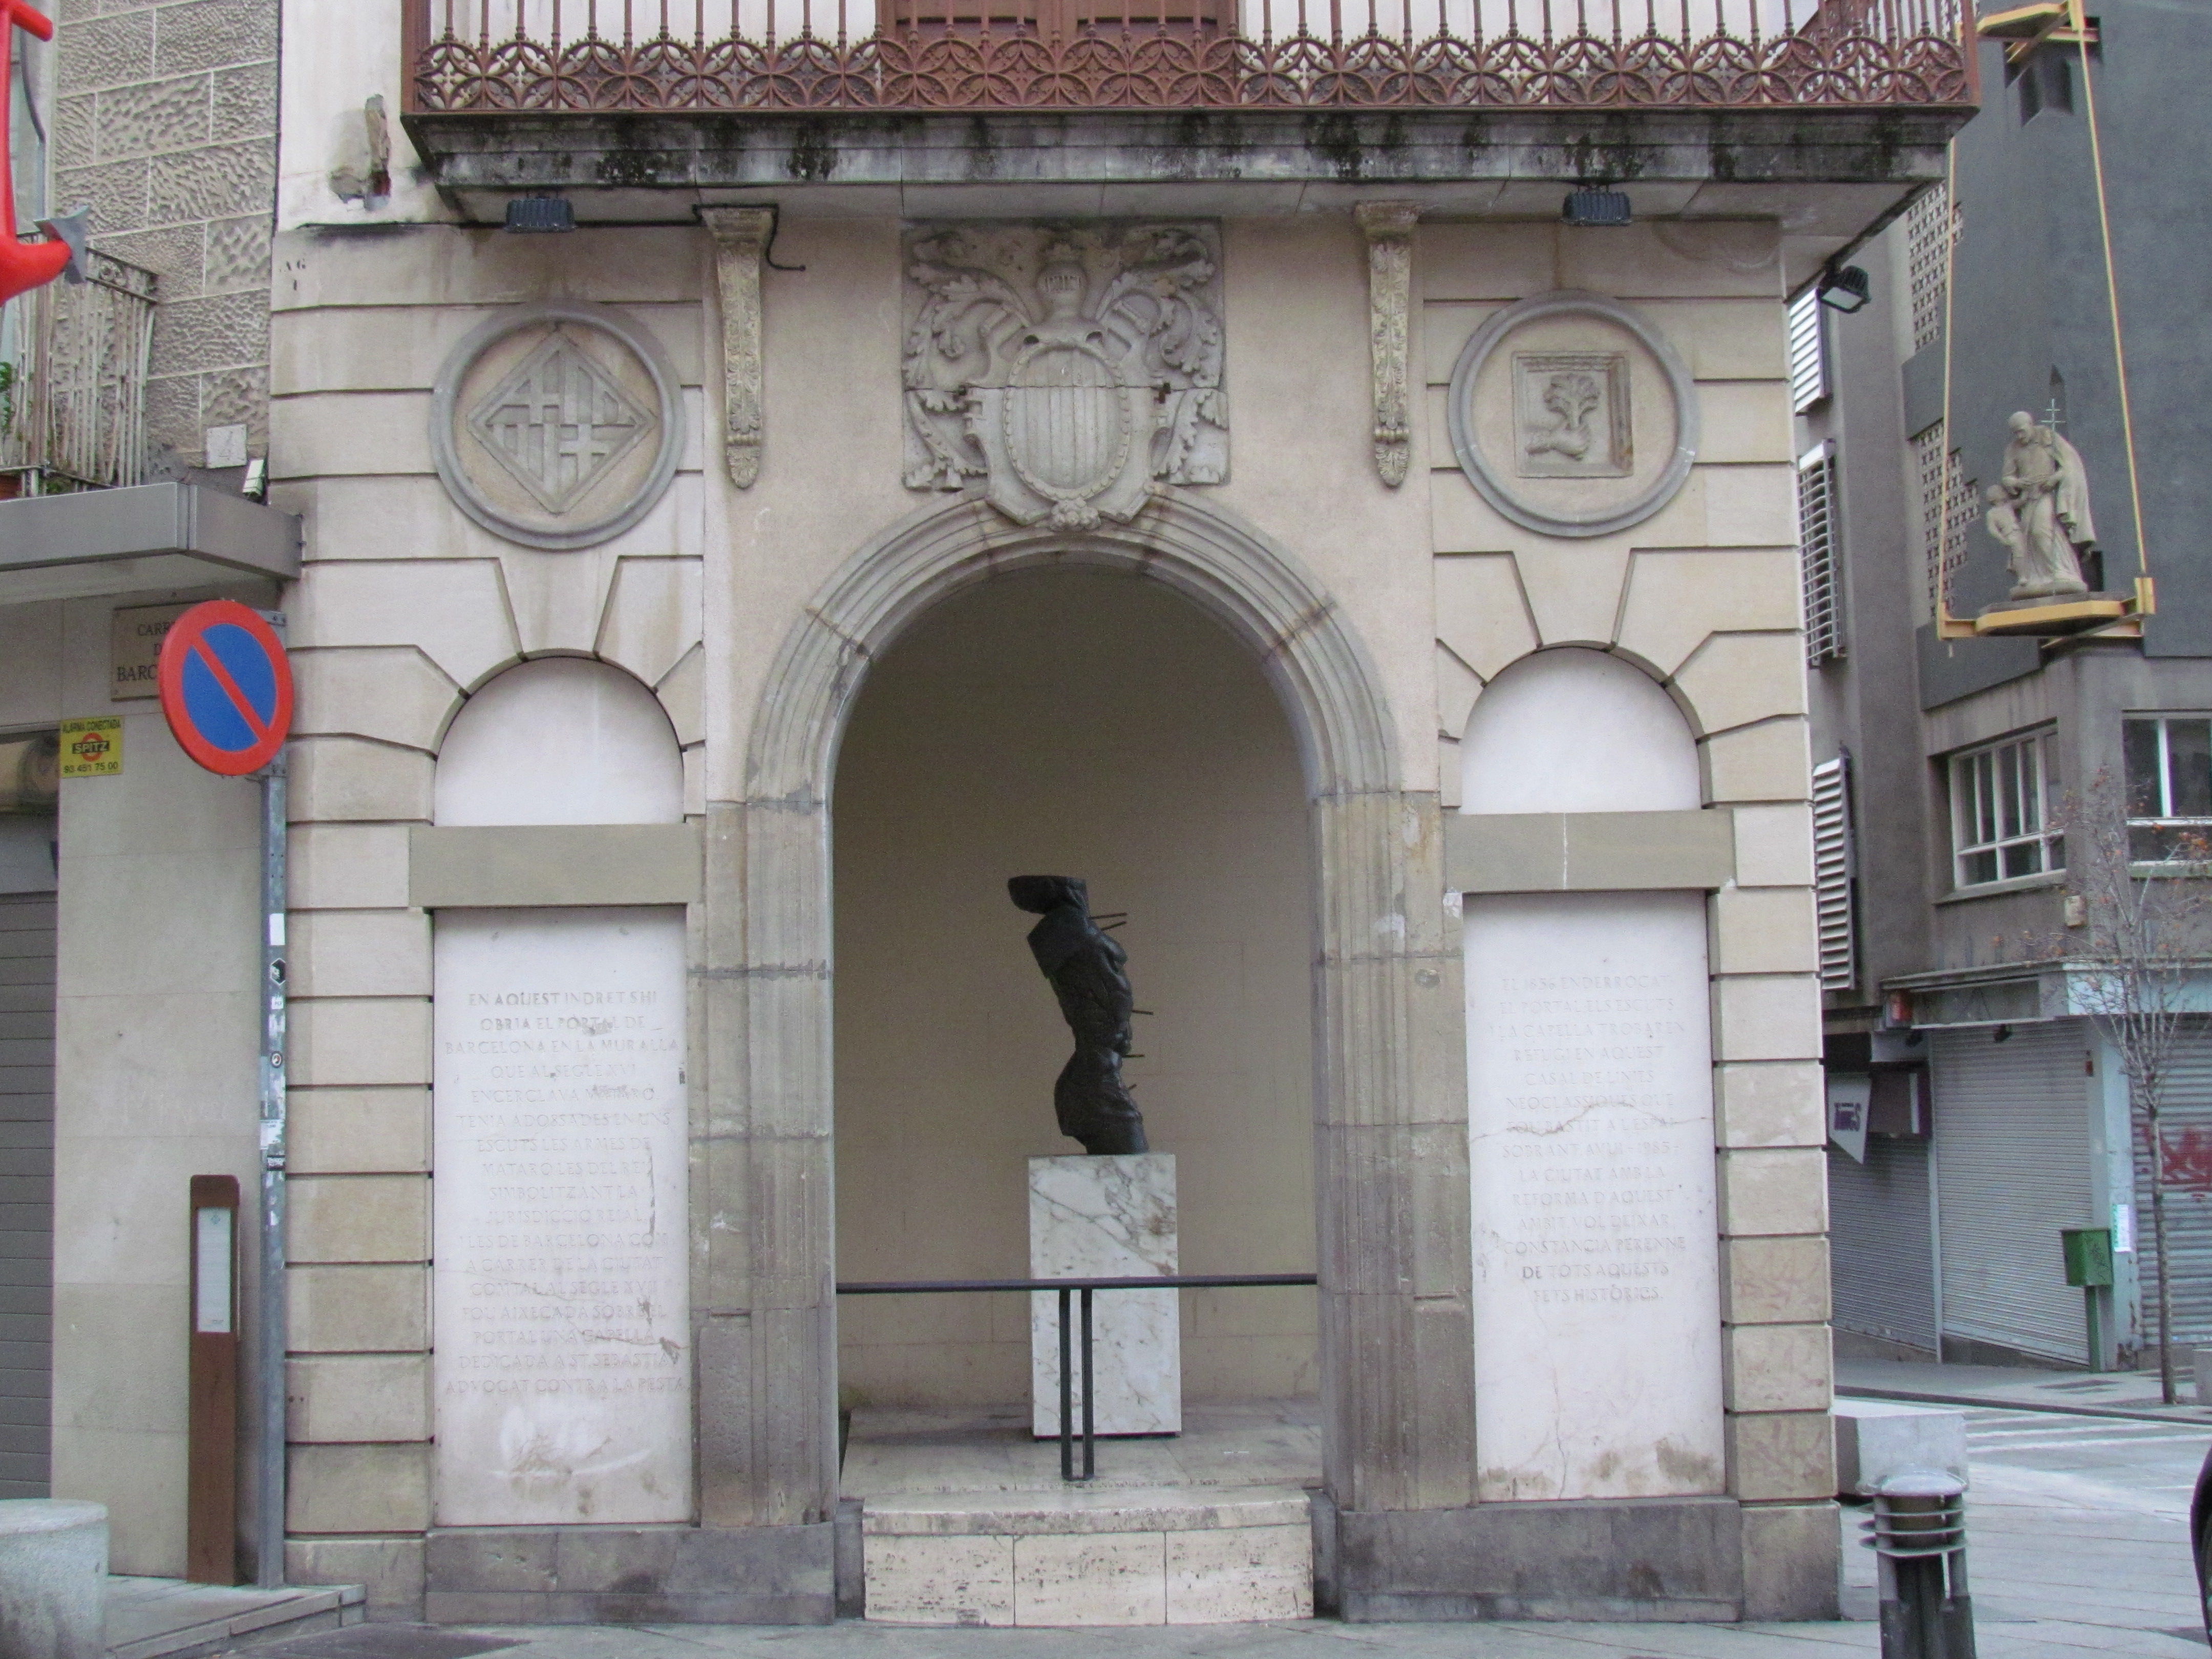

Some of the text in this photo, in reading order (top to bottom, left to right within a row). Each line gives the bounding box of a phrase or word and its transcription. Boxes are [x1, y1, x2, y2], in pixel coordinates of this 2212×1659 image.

[137, 622, 175, 636] CARR
[74, 741, 109, 753] SPITZ
[108, 761, 118, 770] 00
[1502, 977, 1519, 991] EL
[468, 992, 489, 1006] EN
[495, 991, 560, 1006] AQUEST
[565, 991, 625, 1005] INDRET
[1500, 998, 1674, 1014] EL PORTAL ELS ESCUTS
[481, 1018, 530, 1031] OBRIA
[537, 1017, 553, 1030] EL
[625, 1016, 645, 1029] DE
[1498, 1025, 1517, 1038] LA
[1523, 1024, 1593, 1038] CAPELLA
[1598, 1022, 1685, 1036] TROBAREN
[445, 1038, 678, 1055] BARCELONA EN LA MURALLA
[1514, 1046, 1665, 1062] REFUGI EN AQUEST
[491, 1066, 524, 1079] QUE
[554, 1064, 602, 1078] SEGLE
[1524, 1072, 1577, 1086] CASAL
[1582, 1071, 1602, 1084] DE
[472, 1090, 580, 1103] ENCERCLAVA
[1641, 1093, 1674, 1107] QUE
[513, 1114, 609, 1127] ADOSSADES
[614, 1113, 633, 1126] EN
[478, 1138, 538, 1152] ESCUTS
[543, 1138, 567, 1151] LES
[574, 1137, 625, 1151] ARMES
[1502, 1143, 1579, 1158] SOBRANT
[558, 1162, 583, 1176] LES
[587, 1162, 617, 1175] DEL
[1519, 1169, 1539, 1182] LA
[1544, 1167, 1603, 1182] CIUTAT
[1645, 1166, 1666, 1179] LA
[490, 1185, 638, 1200] SIMBOLITZANT LA
[1513, 1192, 1589, 1206] REFORMA
[1572, 1216, 1606, 1229] VOL
[1610, 1214, 1669, 1228] DEIXAR
[469, 1235, 494, 1248] LES
[498, 1235, 518, 1247] DE
[524, 1233, 624, 1248] BARCELONA
[1617, 1237, 1686, 1252] PERENNE
[466, 1256, 664, 1273] A CARRER DE LA CIUTAT
[1522, 1262, 1669, 1280] DE TOTS AQUESTS
[571, 1281, 619, 1294] SEGLE
[1534, 1289, 1570, 1303] FETS
[464, 1306, 496, 1320] FOU
[500, 1305, 589, 1320] AIXECADA
[474, 1331, 537, 1345] PORTAL
[459, 1354, 550, 1369] DEDICADA
[445, 1379, 530, 1394] ADVOCAT
[535, 1377, 608, 1394] CONTRA
[613, 1377, 634, 1391] LA
